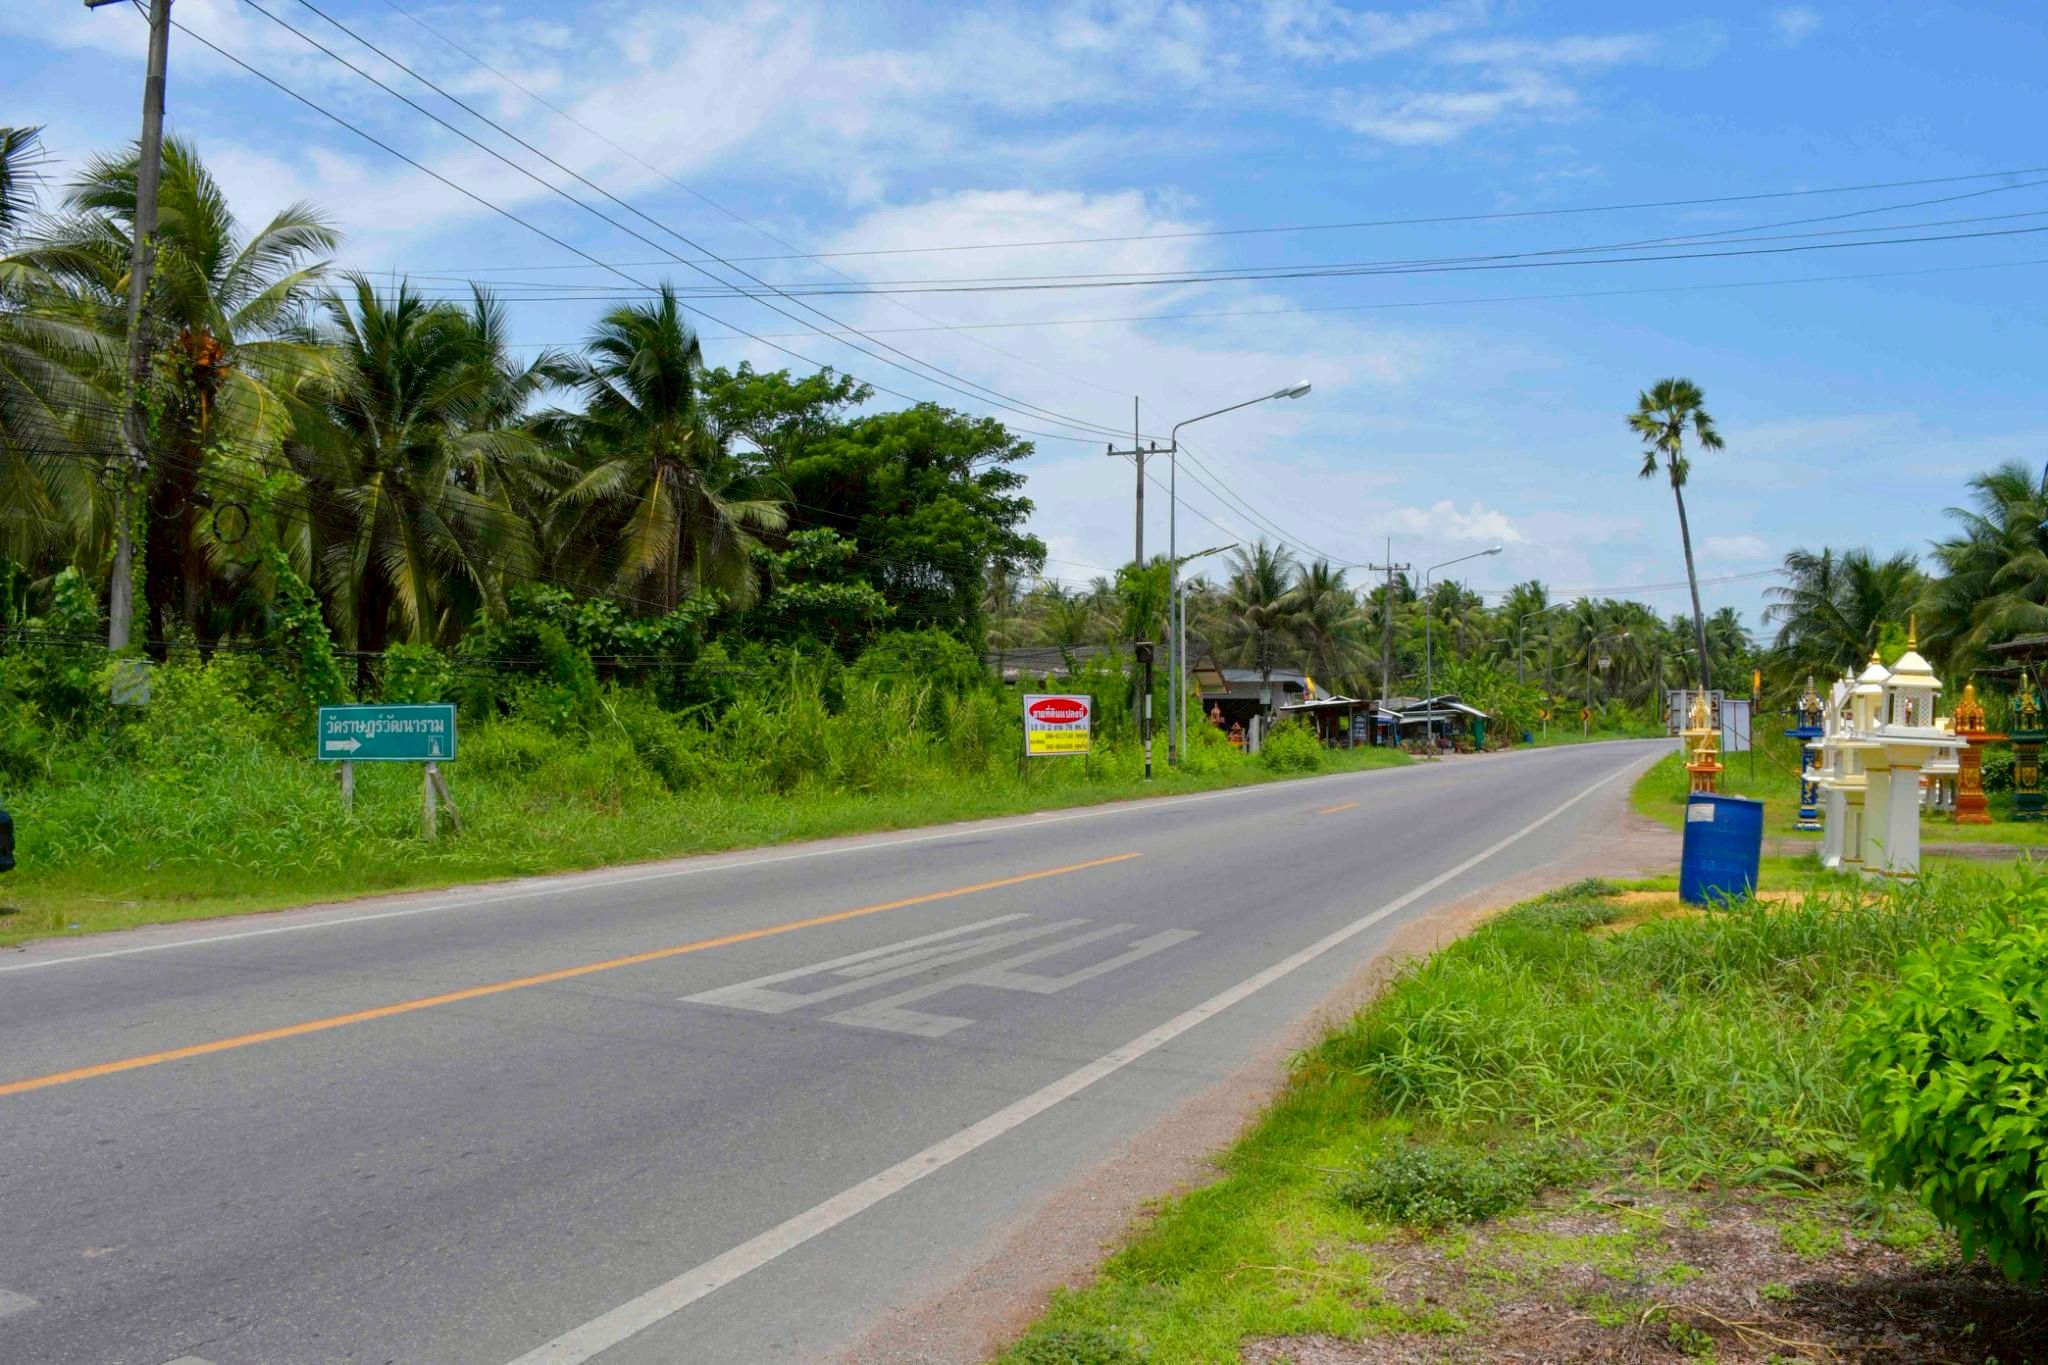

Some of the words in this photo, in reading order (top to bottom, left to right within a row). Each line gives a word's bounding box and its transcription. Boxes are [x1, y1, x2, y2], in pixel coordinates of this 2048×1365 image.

[326, 714, 444, 738] วัดราษฎร์วัฒนาราม
